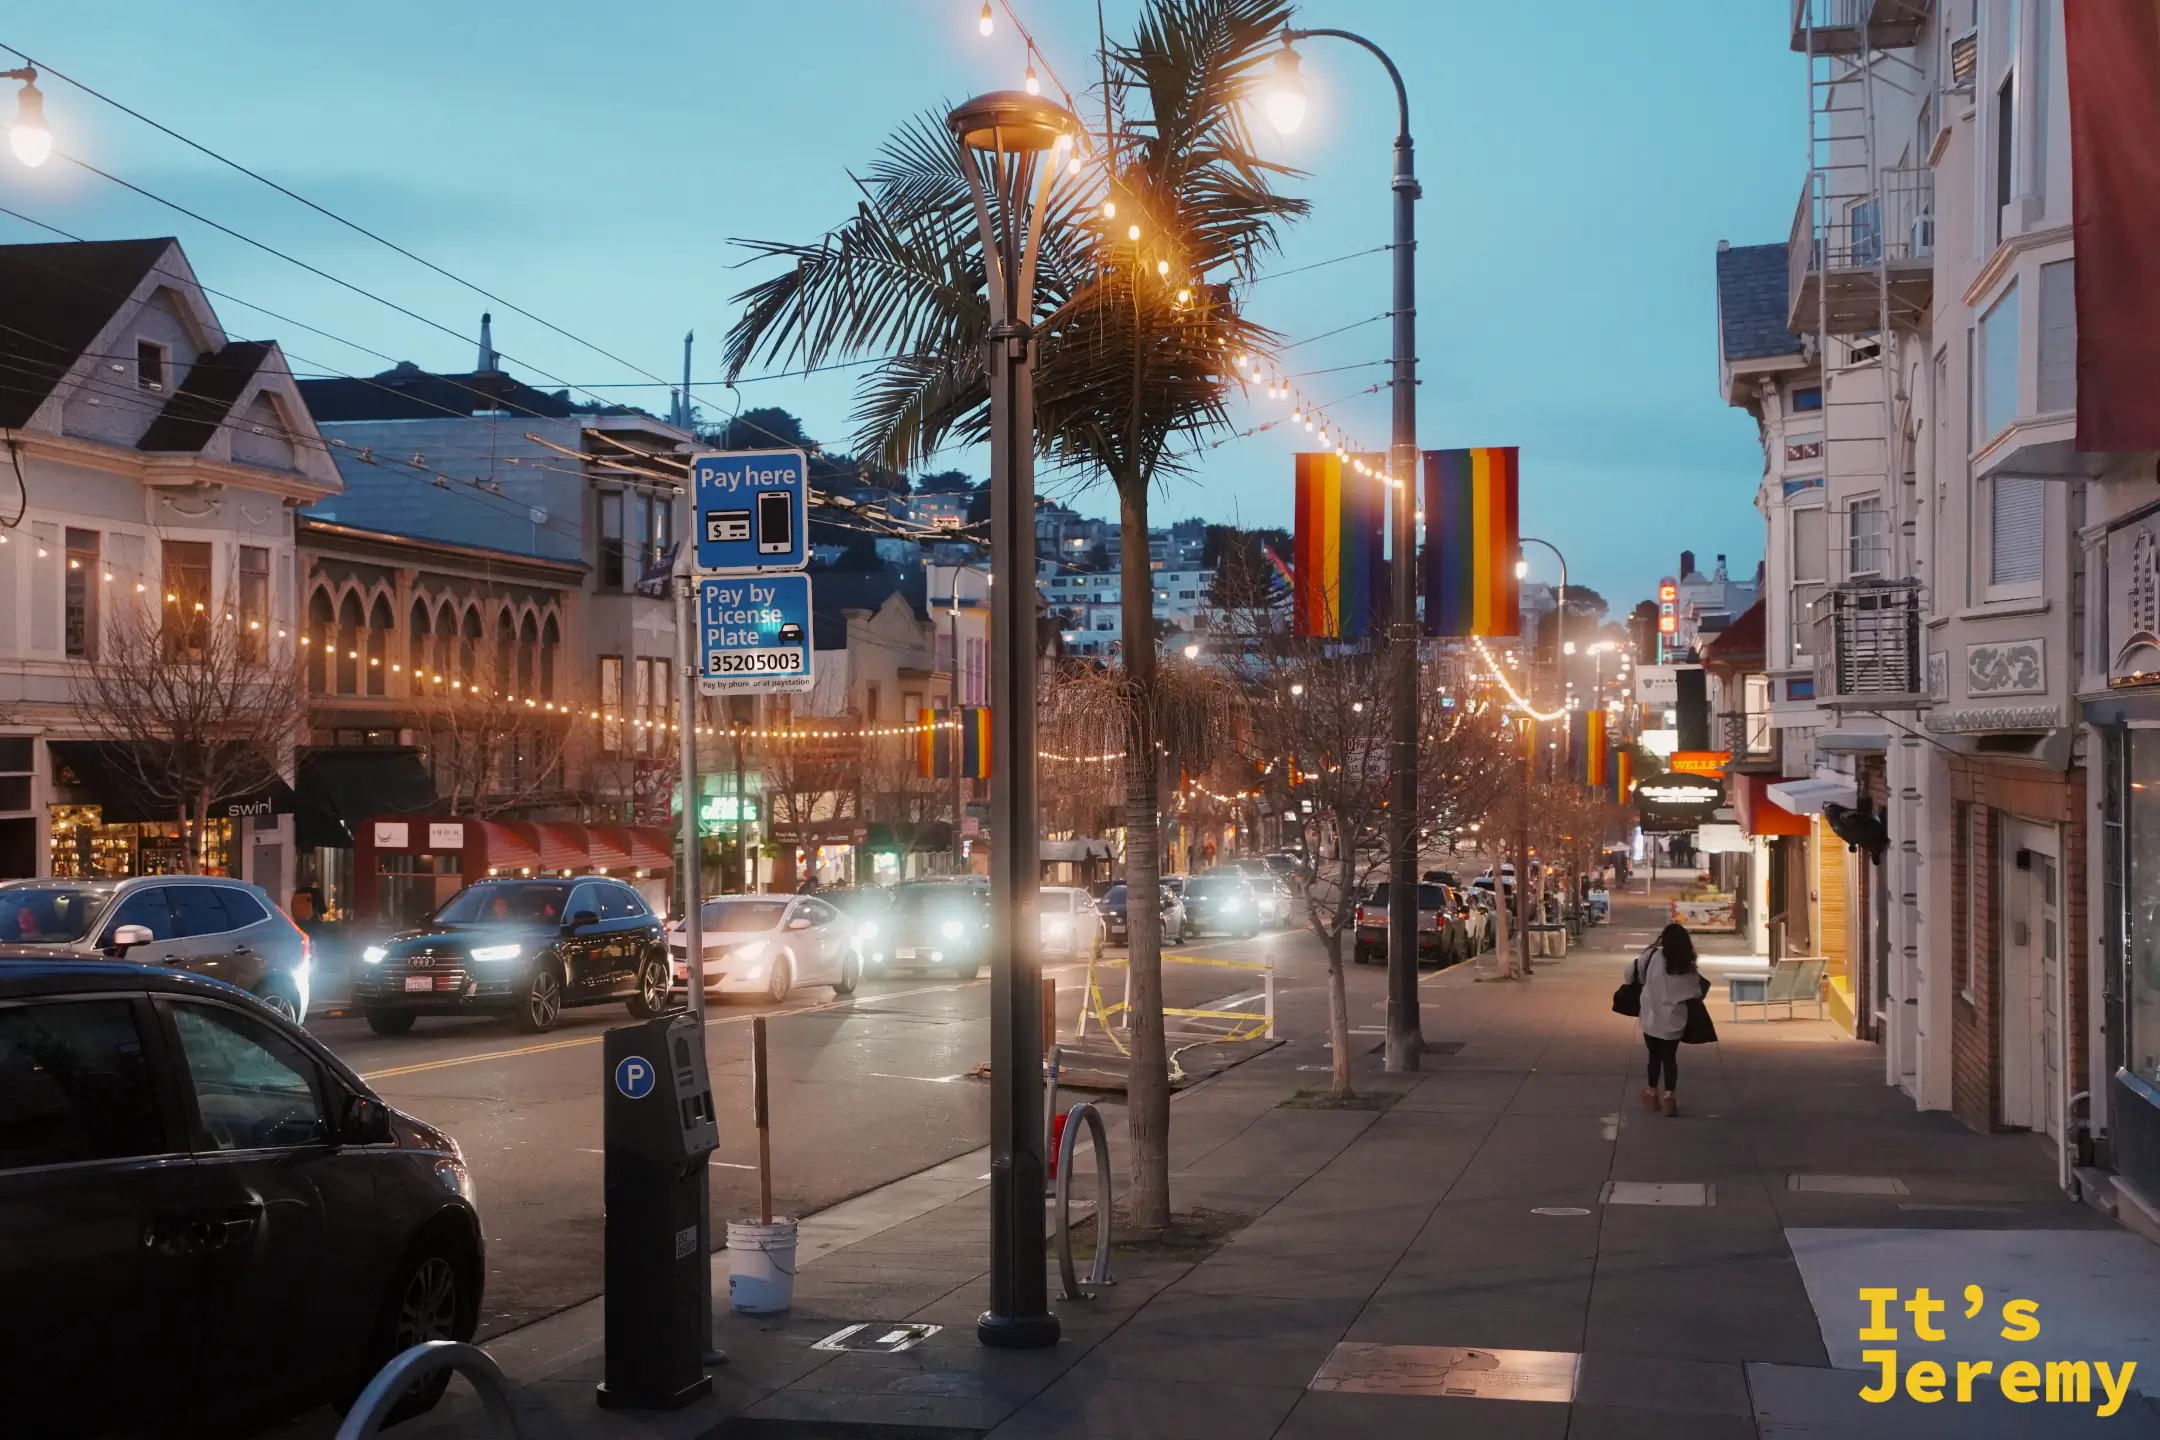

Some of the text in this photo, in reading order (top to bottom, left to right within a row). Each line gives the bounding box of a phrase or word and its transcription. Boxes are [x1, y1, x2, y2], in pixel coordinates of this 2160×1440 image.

[701, 465, 797, 492] Pay here
[706, 583, 776, 608] Pay by
[706, 606, 783, 625] License
[707, 628, 760, 647] Plate
[711, 653, 800, 673] 35205003
[702, 681, 716, 690] Pay
[717, 680, 727, 690] by
[772, 678, 810, 690] paystation
[1672, 760, 1717, 770] WELLS
[228, 796, 272, 817] swirl
[627, 1064, 645, 1091] P
